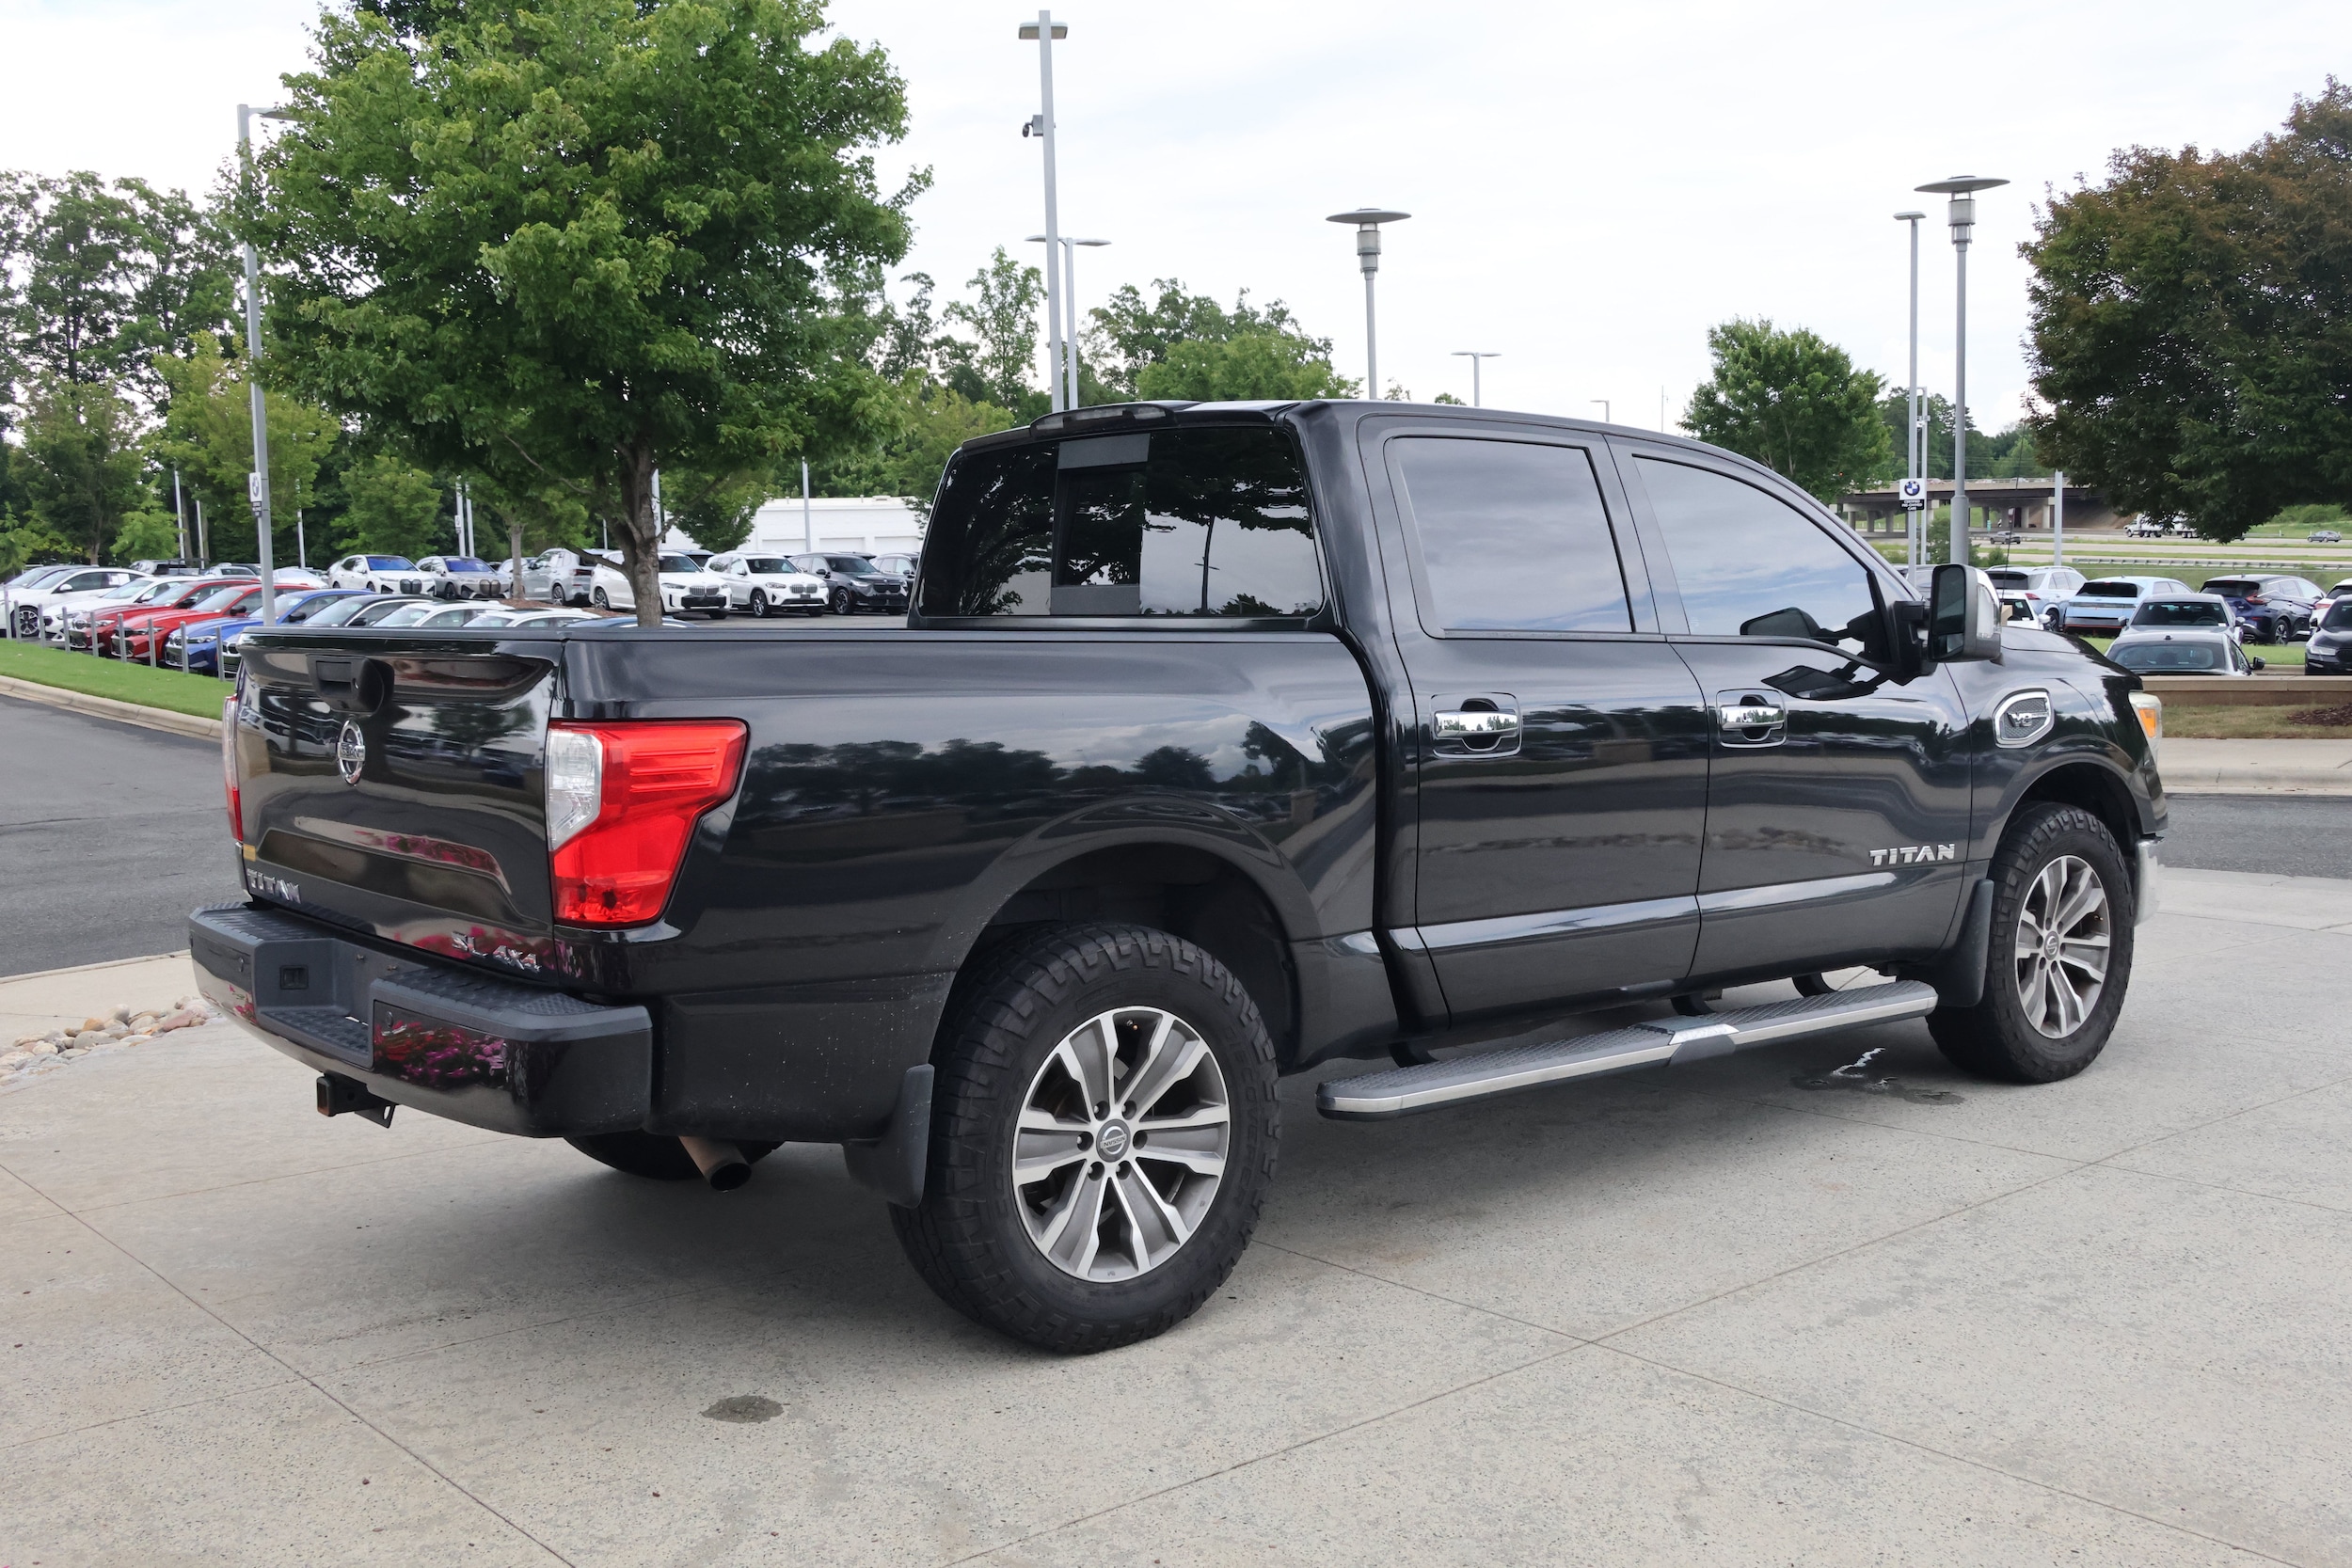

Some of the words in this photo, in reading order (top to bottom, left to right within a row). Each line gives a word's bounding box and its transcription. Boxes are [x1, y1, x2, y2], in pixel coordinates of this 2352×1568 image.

[1869, 844, 1955, 866] TITAN
[246, 868, 301, 904] TITAN
[452, 931, 488, 957] SL
[1104, 1135, 1126, 1147] NISSAN
